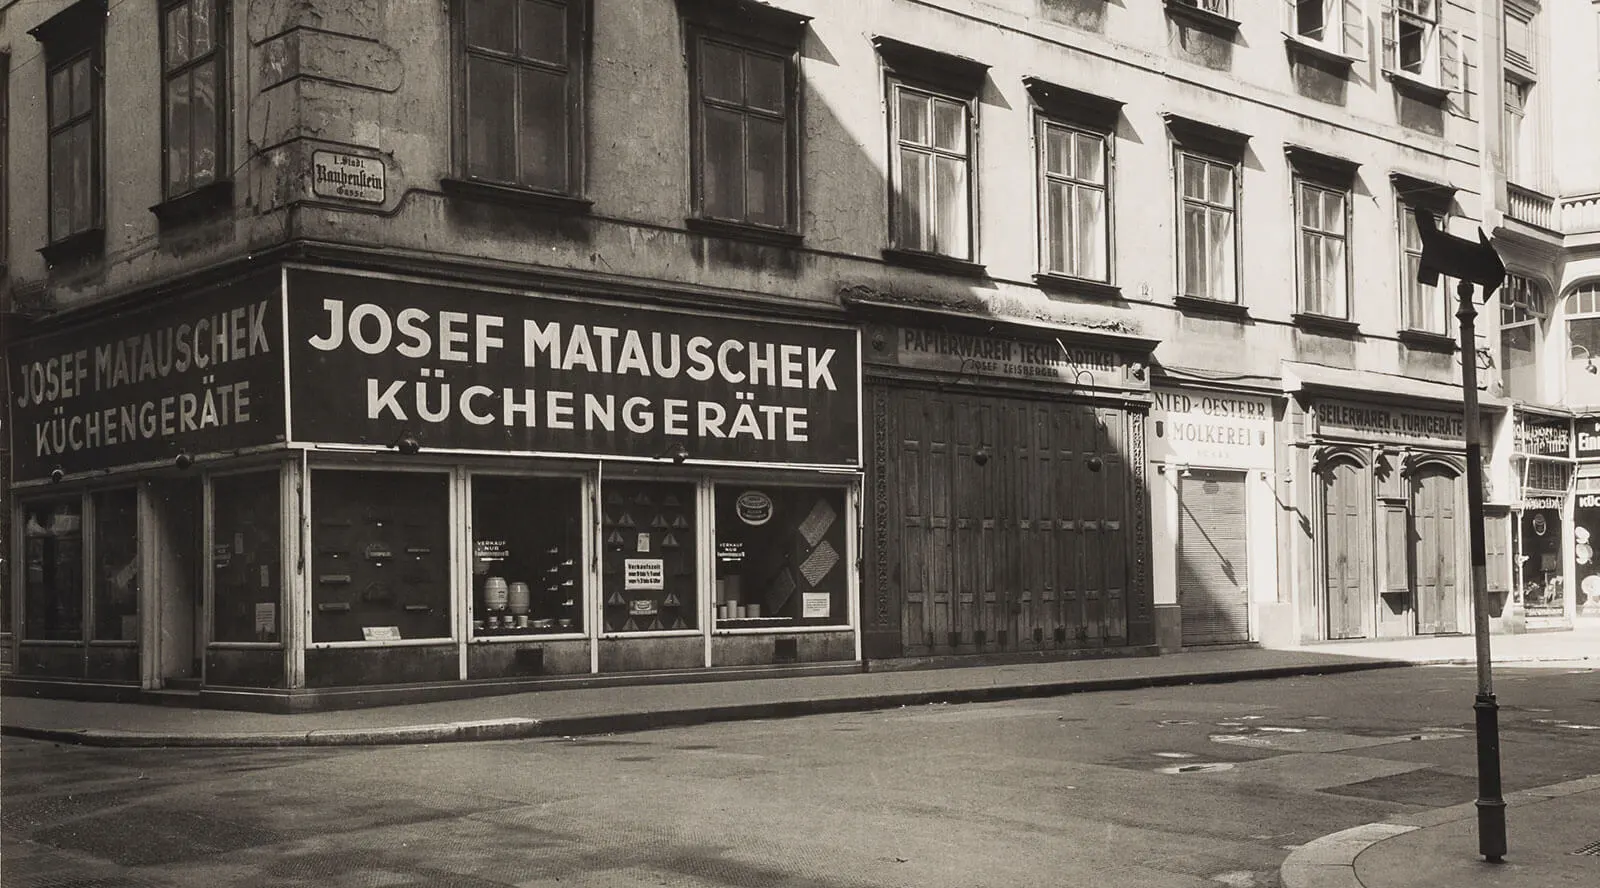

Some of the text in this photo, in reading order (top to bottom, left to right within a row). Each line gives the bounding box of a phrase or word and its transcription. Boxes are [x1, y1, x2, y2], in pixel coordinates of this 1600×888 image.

[18, 300, 270, 408] JOSEF MATAUSCHEK
[308, 299, 838, 391] JOSEF MATAUSCHEK
[903, 327, 1012, 361] PAPIERWAREN
[971, 360, 998, 372] JOSEF
[36, 375, 250, 457] KÜCHENGERÄTE
[367, 368, 809, 442] KÜCHENGERÄTE
[1319, 403, 1391, 428] SEILERWAREN
[1173, 421, 1252, 446] MOLKEREI
